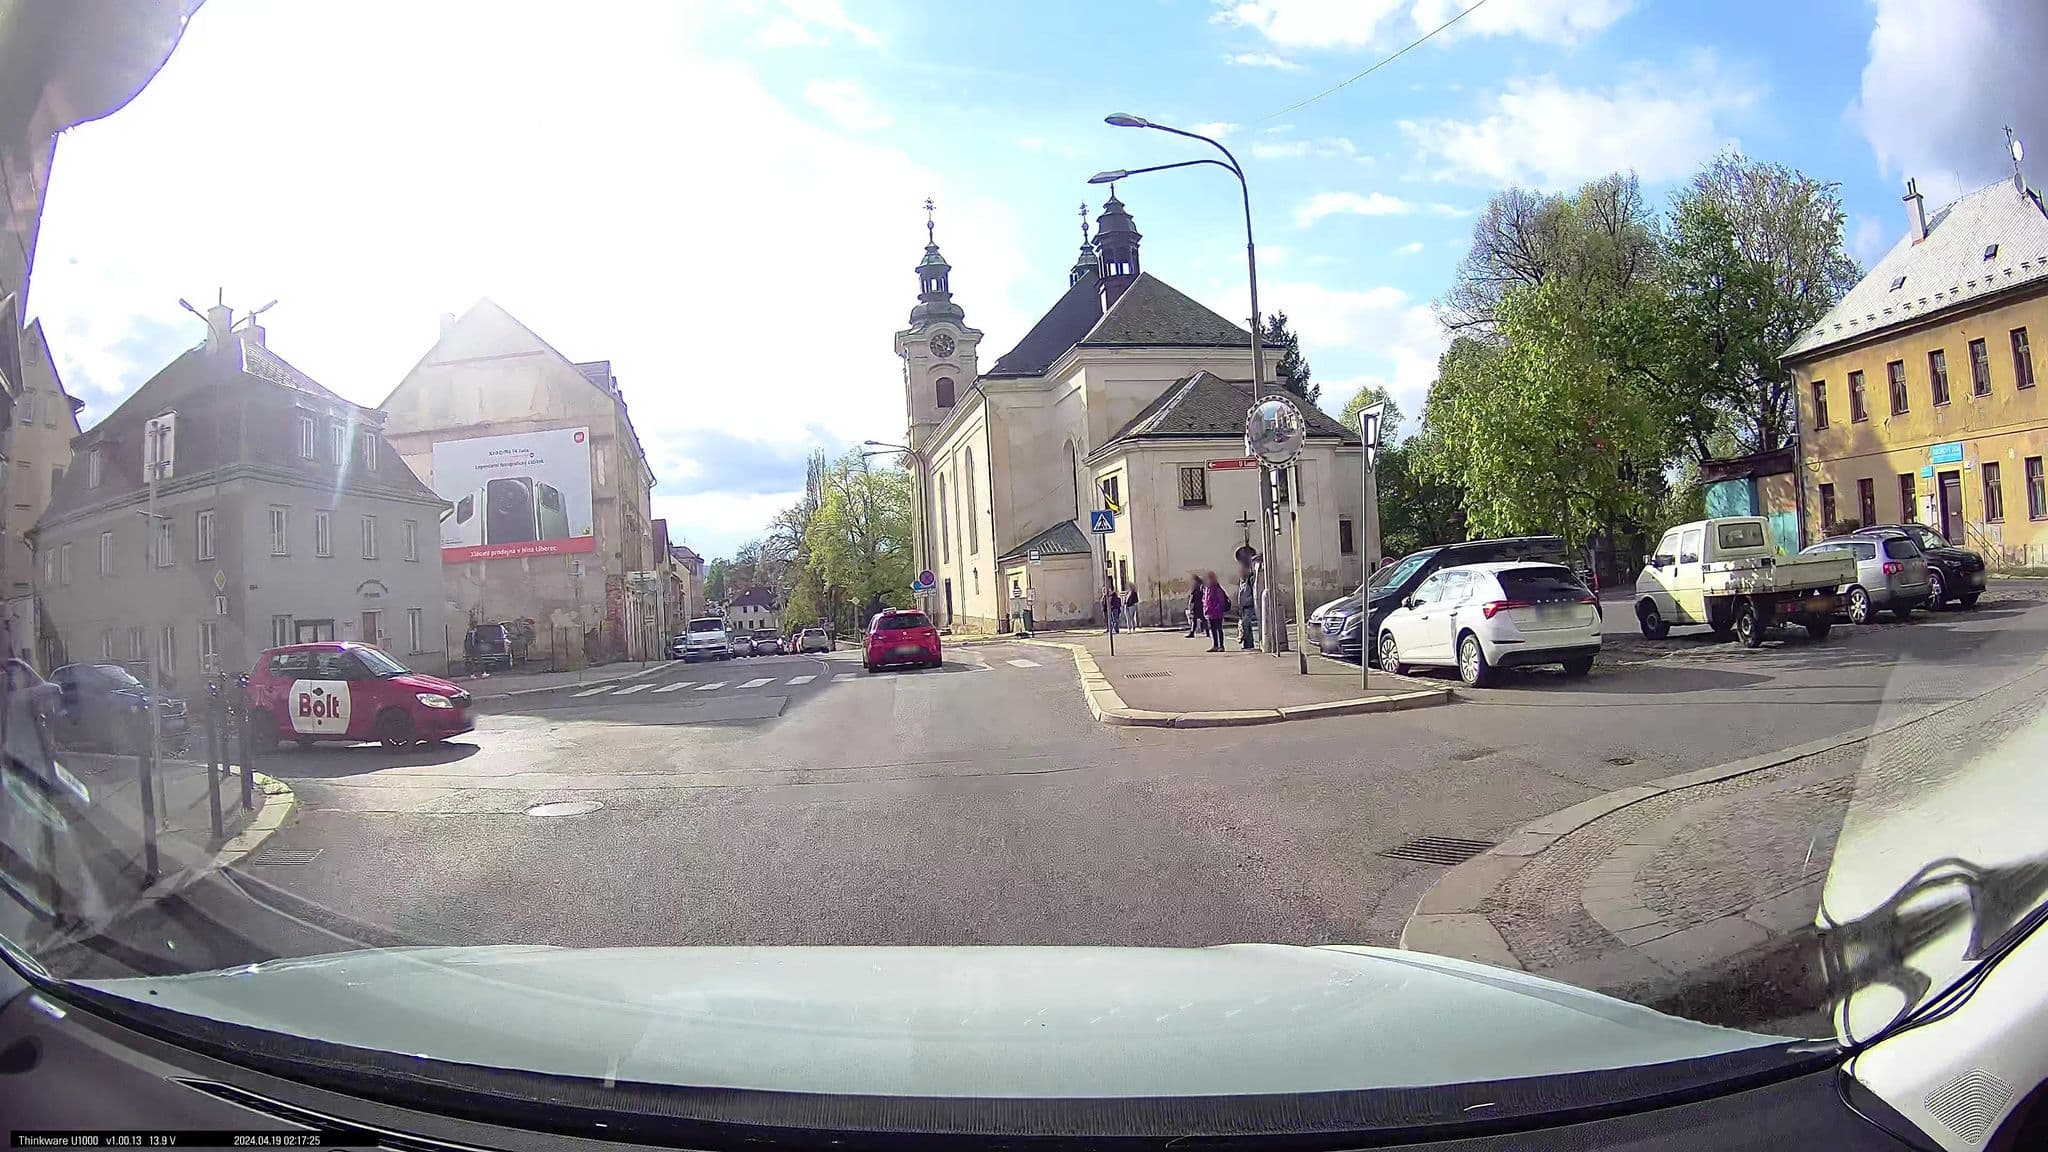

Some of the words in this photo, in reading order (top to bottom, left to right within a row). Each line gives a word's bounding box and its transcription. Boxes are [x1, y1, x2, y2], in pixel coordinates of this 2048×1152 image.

[492, 549, 516, 557] prodejna
[535, 544, 558, 552] Liberec
[299, 693, 340, 718] Bolt
